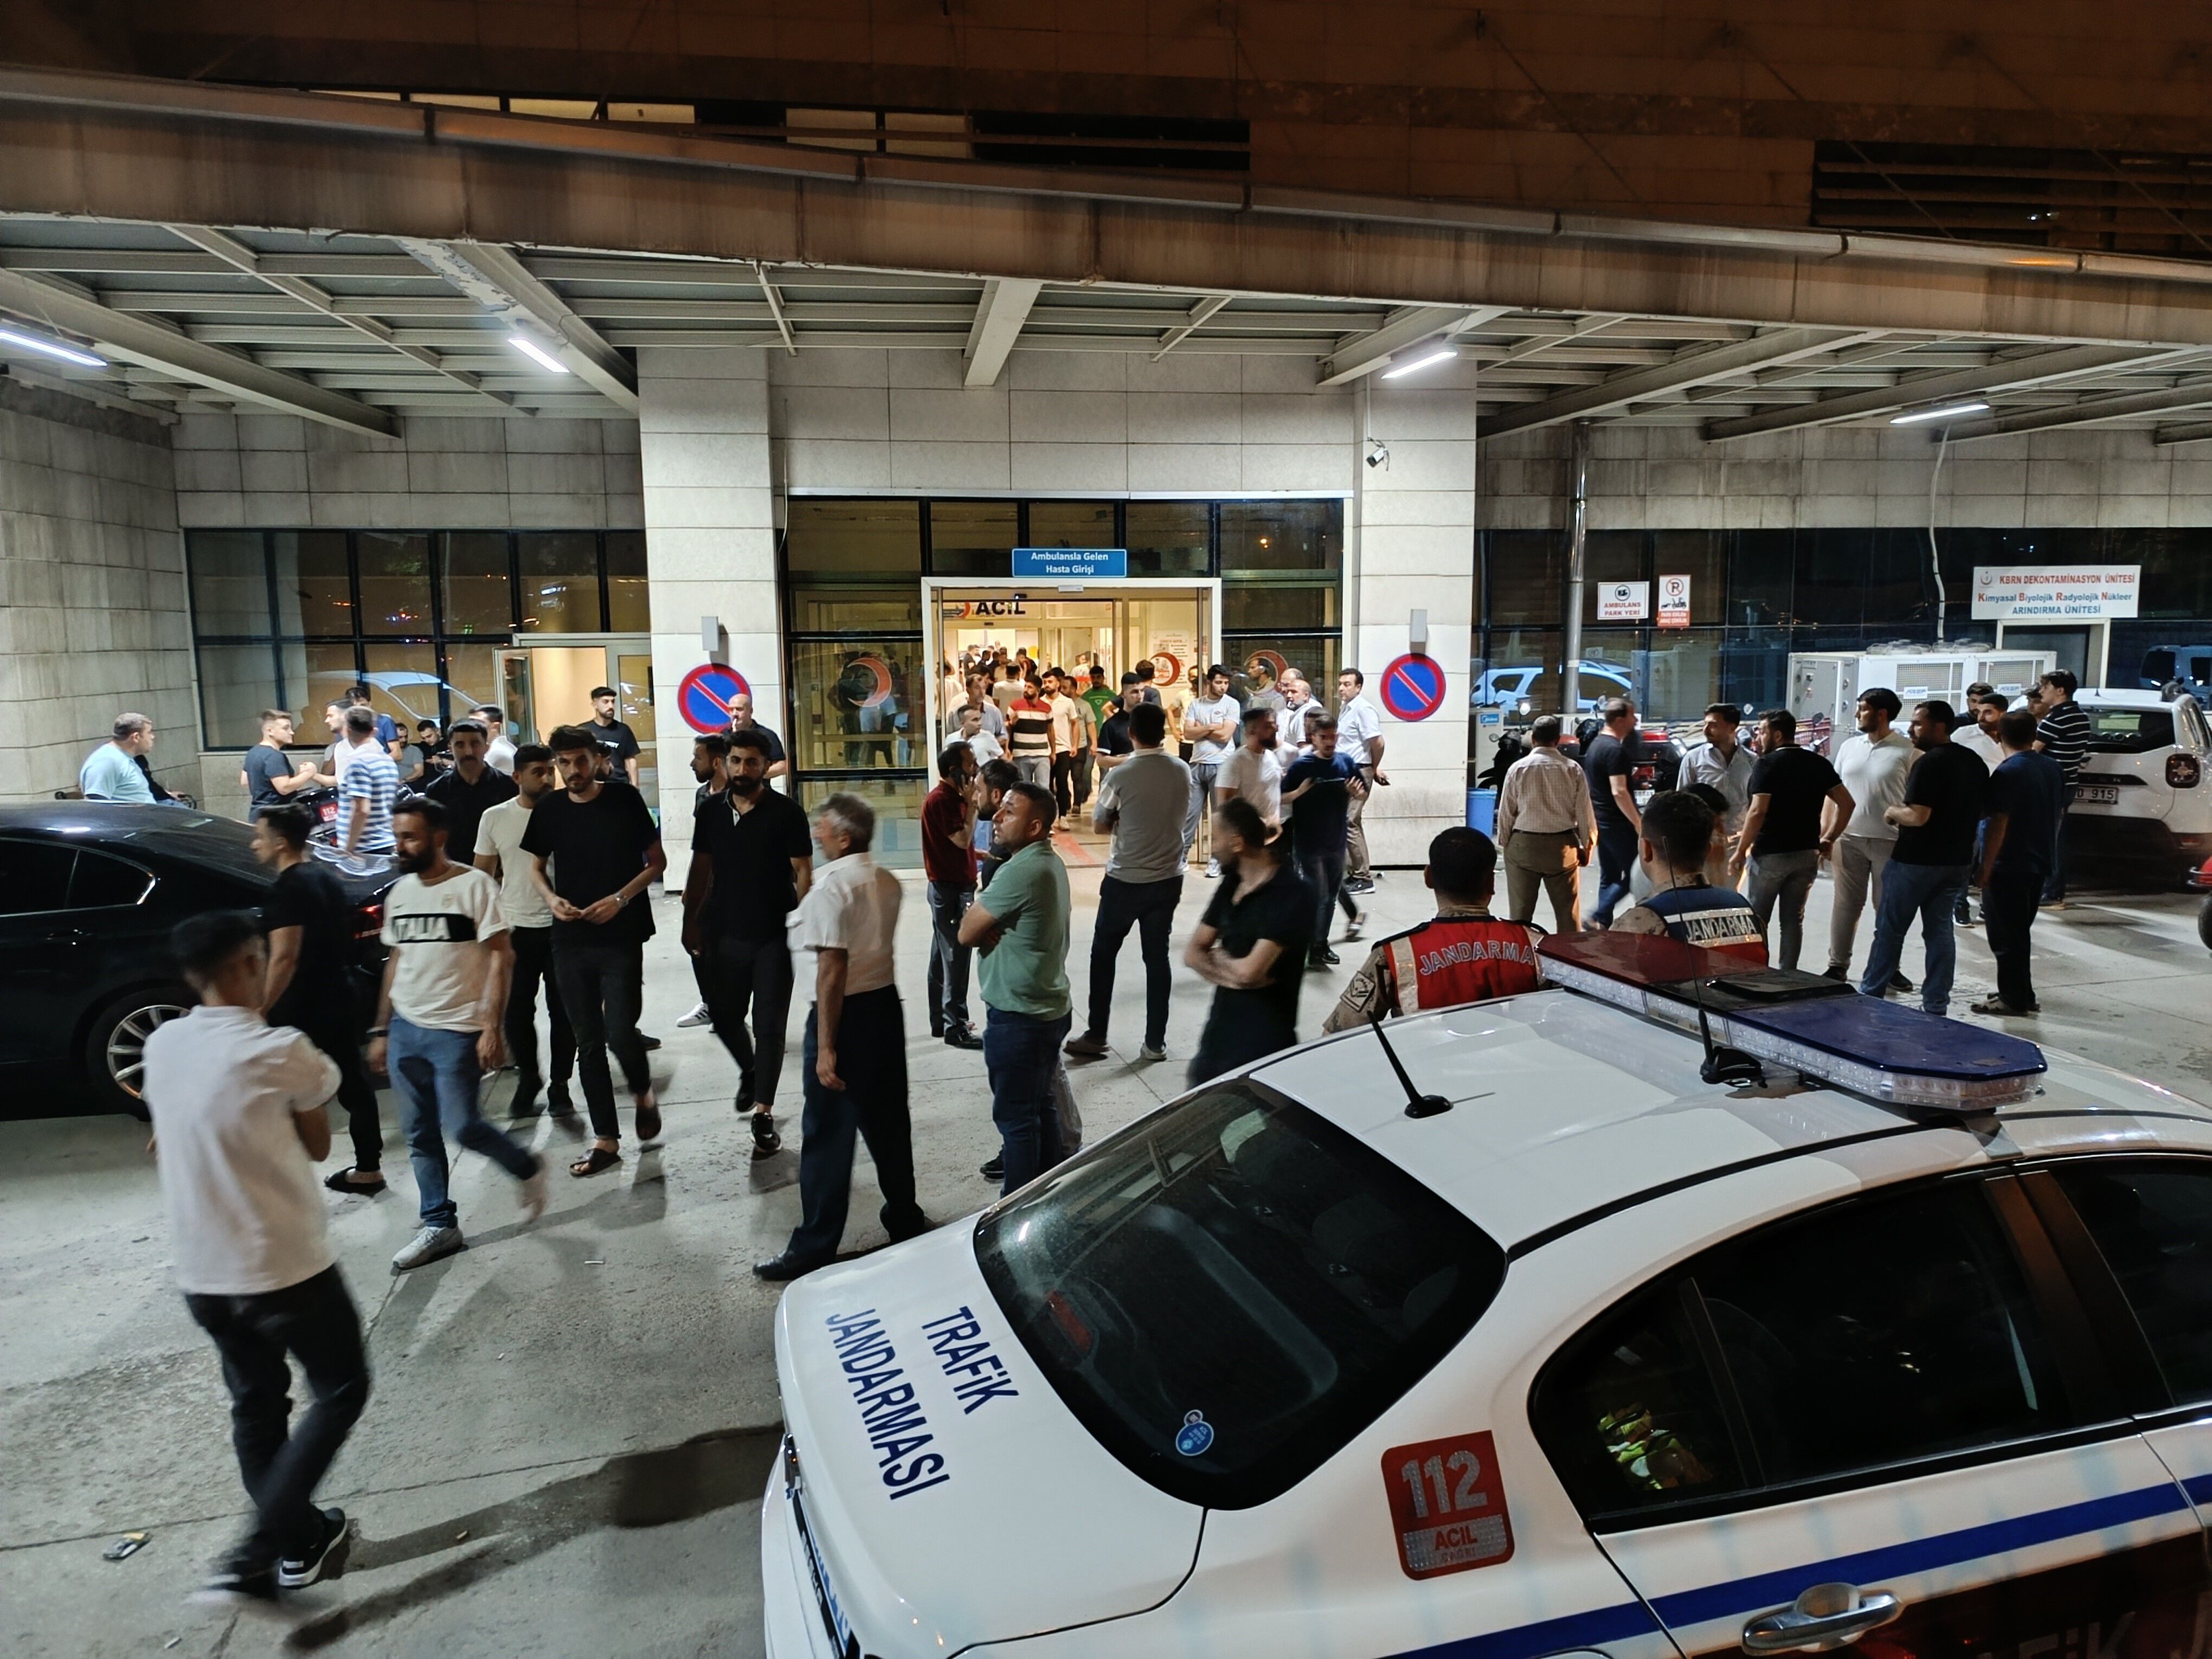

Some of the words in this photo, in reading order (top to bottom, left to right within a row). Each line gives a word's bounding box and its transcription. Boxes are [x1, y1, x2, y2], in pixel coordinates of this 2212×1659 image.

[1031, 552, 1081, 561] Ambulansla
[1083, 552, 1108, 561] Gelen
[1046, 565, 1070, 573] Hasta
[1072, 564, 1094, 575] Girişi
[1999, 575, 2022, 584] KBRN
[2023, 573, 2101, 584] DEKONTAMİNASYON
[2105, 573, 2135, 583] ÜNİTESİ
[1978, 593, 2016, 603] Kimyasal
[2019, 593, 2053, 603] Biyolojik
[2056, 592, 2099, 602] Radyolojik
[2012, 606, 2061, 614] ARINDIRMA
[2065, 605, 2101, 614] ÜNİTESİ
[2092, 789, 2114, 799] 915
[1686, 915, 1758, 942] JANDARMA
[1420, 940, 1534, 975] JANDARMA
[922, 1306, 1019, 1415] TRAFİK
[825, 1308, 950, 1500] JANDARMASI
[1401, 1450, 1488, 1519] 112
